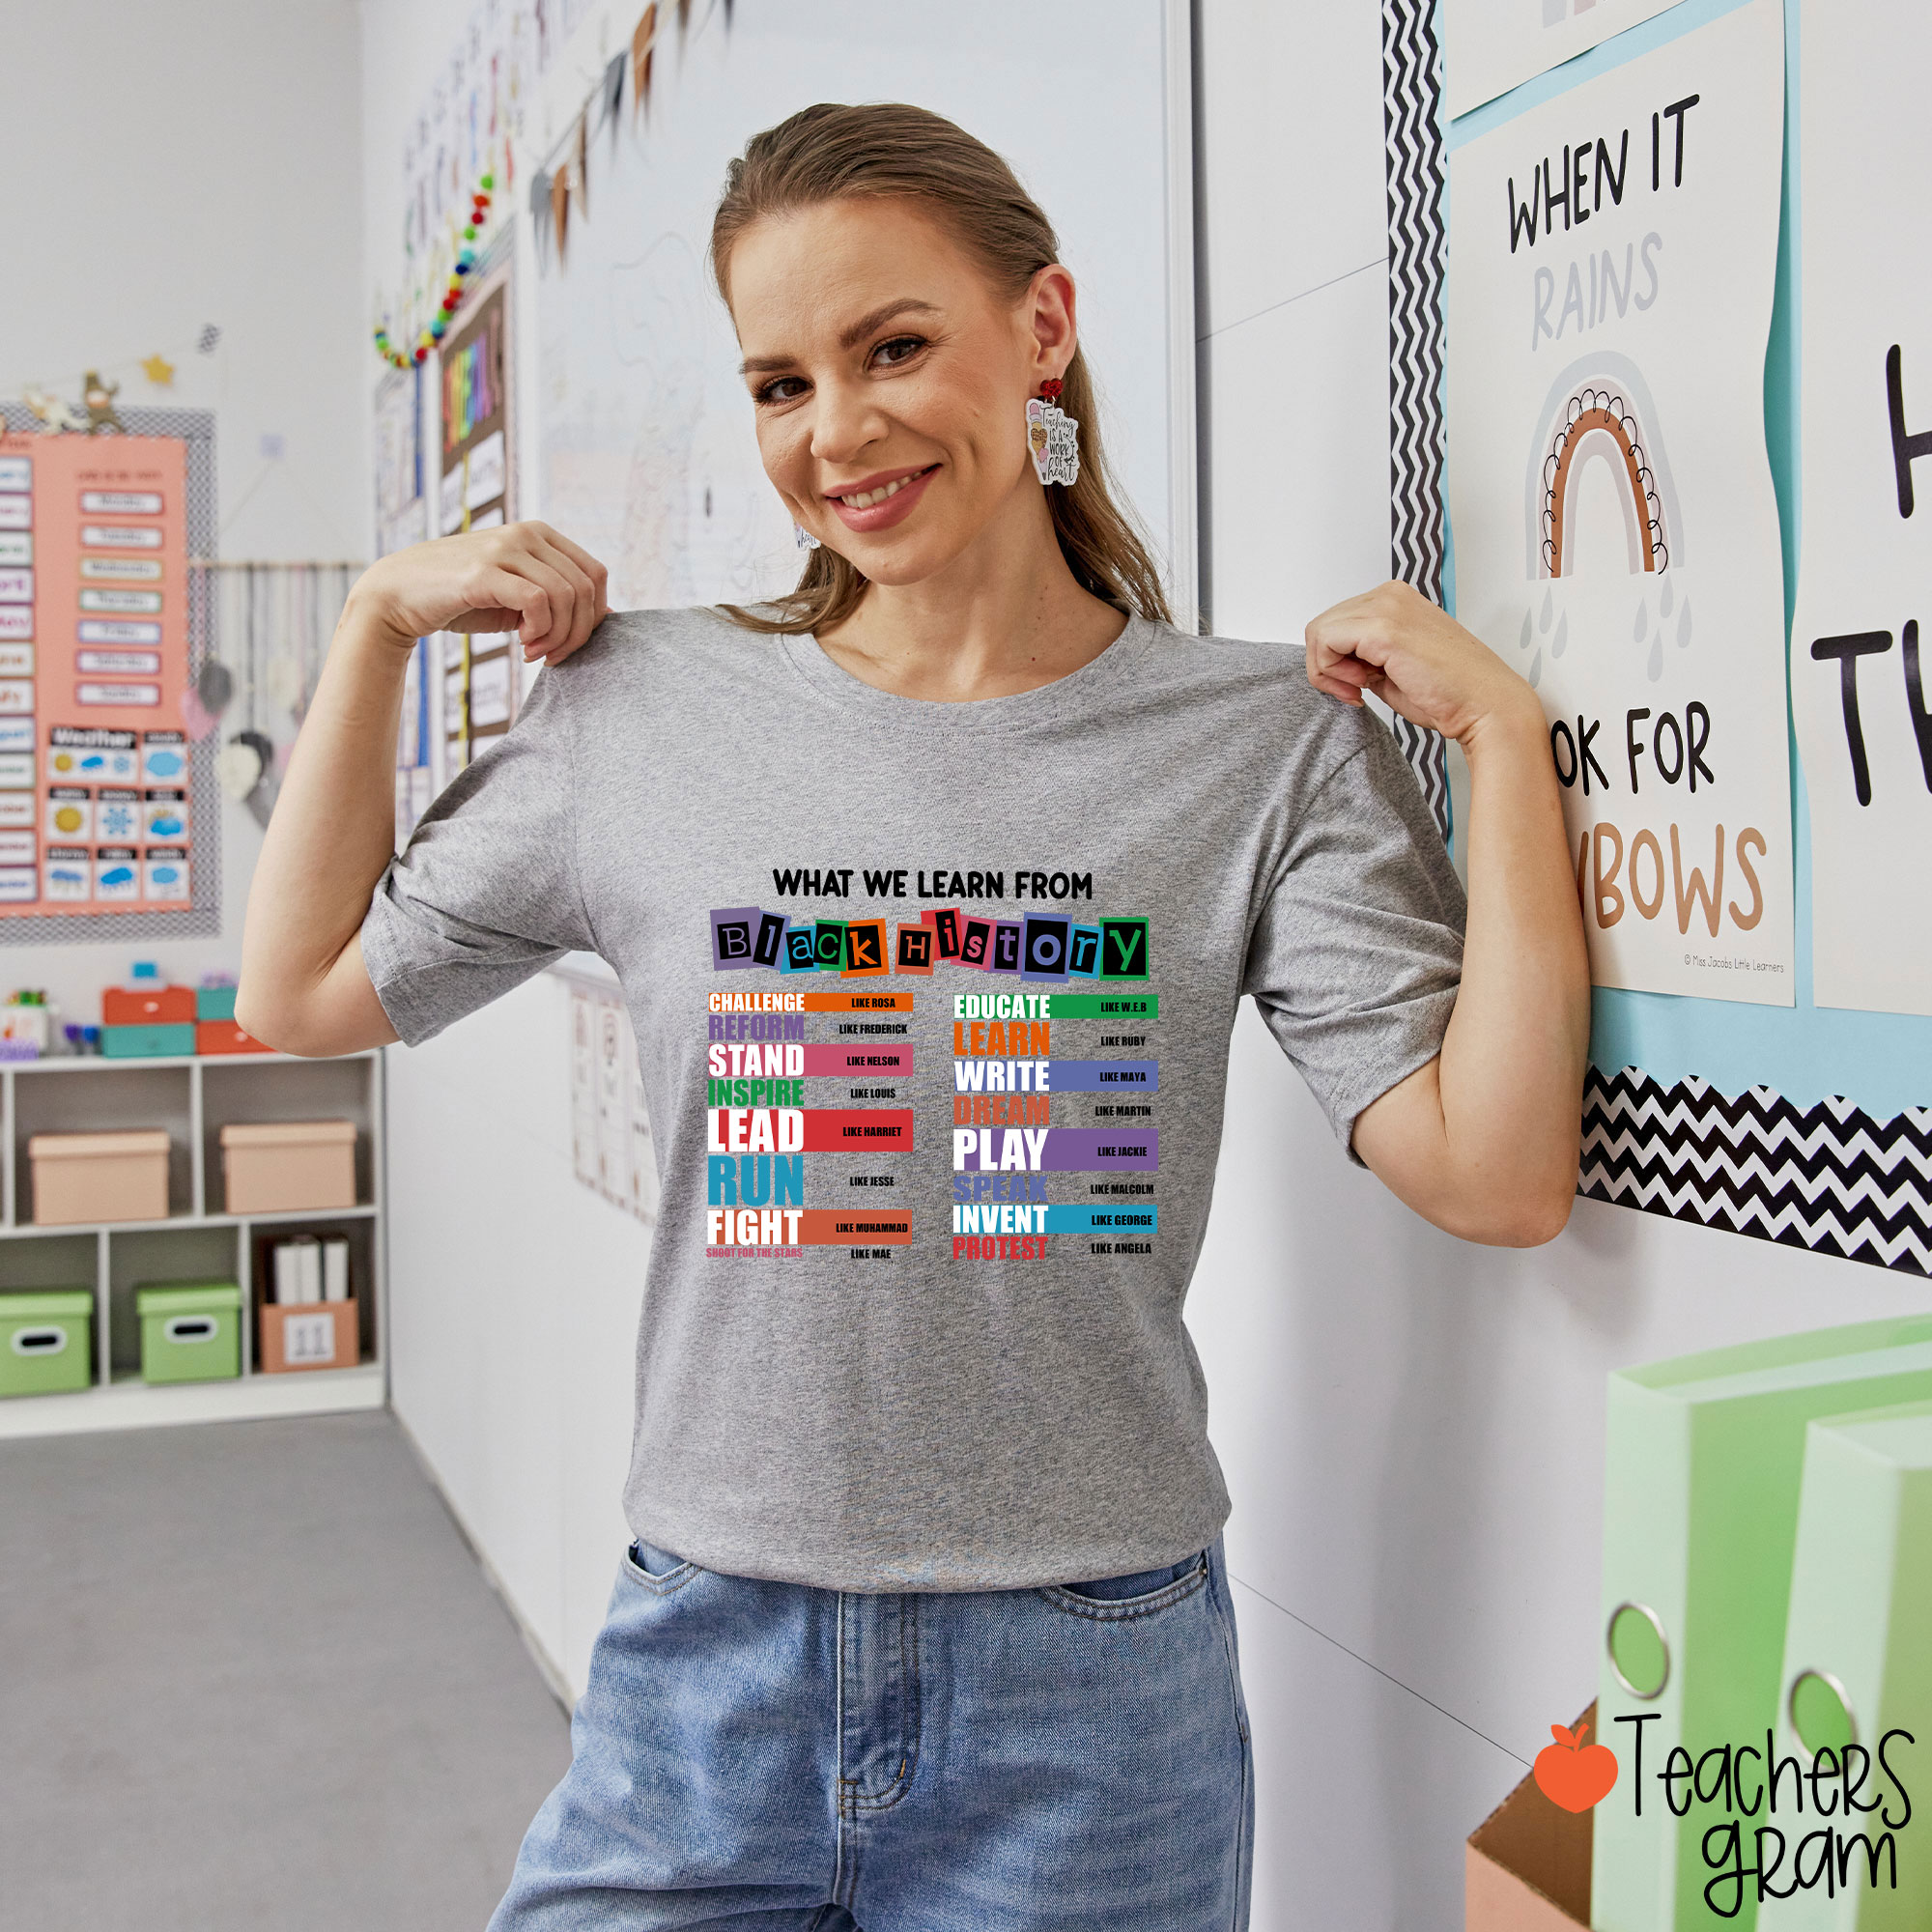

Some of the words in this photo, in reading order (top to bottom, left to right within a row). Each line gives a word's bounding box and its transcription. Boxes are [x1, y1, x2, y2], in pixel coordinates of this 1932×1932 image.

[1508, 129, 1628, 254] WHEN
[1652, 94, 1700, 191] IT
[1532, 232, 1662, 352] RAINS
[1050, 429, 1056, 441] IS
[1059, 430, 1063, 441] A
[1050, 443, 1068, 456] WORK
[1048, 457, 1076, 481] heart
[1055, 456, 1063, 467] OF
[1550, 715, 1609, 796] OK
[1627, 701, 1715, 794] FOR
[773, 869, 853, 897] WHAT
[864, 870, 908, 896] WE
[919, 871, 1003, 898] LEARN
[1016, 872, 1092, 899] FROM
[1577, 822, 1767, 938] BOWS
[721, 923, 880, 968] Black
[903, 916, 1143, 972] History
[1707, 955, 1732, 969] Jacobs
[1734, 957, 1750, 970] Little
[1752, 959, 1784, 973] Learners
[710, 994, 804, 1011] CHALLENGE
[851, 997, 869, 1009] LIKE
[872, 997, 895, 1009] ROSA
[954, 995, 1050, 1018] EDUCATE
[1100, 1002, 1119, 1013] LIKE
[1122, 1002, 1148, 1012] W.E.B
[709, 1015, 804, 1039] REFORM
[838, 1024, 858, 1035] LIKE
[861, 1024, 908, 1035] FREDERICK
[954, 1021, 1050, 1056] LEARN
[1100, 1036, 1120, 1047] LIKE
[1122, 1036, 1147, 1047] RUBY
[709, 1044, 804, 1076] STAND
[846, 1056, 865, 1066] LIKE
[867, 1056, 900, 1066] NELSON
[954, 1062, 1049, 1091] WRITE
[1099, 1071, 1118, 1082] LIKE
[1121, 1071, 1147, 1083] MAYA
[708, 1079, 804, 1106] INSPIRE
[850, 1088, 868, 1099] LIKE
[871, 1088, 896, 1099] LOUIS
[953, 1095, 1049, 1124] DREAM
[1094, 1105, 1114, 1117] LIKE
[1117, 1105, 1151, 1117] MARTIN
[708, 1109, 803, 1151] LEAD
[842, 1126, 862, 1137] LIKE
[865, 1126, 902, 1137] HARRIET
[953, 1129, 1048, 1170] PLAY
[1097, 1146, 1116, 1157] LIKE
[1119, 1146, 1148, 1157] JACKIE
[708, 1155, 803, 1207] RUN
[849, 1176, 867, 1186] LIKE
[870, 1176, 895, 1187] JESSE
[954, 1177, 1047, 1201] SPEAK
[1090, 1183, 1109, 1195] LIKE
[1111, 1183, 1154, 1195] MALCOLM
[707, 1210, 803, 1245] FIGHT
[836, 1223, 853, 1234] LIKE
[856, 1223, 908, 1234] MUHAMMAD
[953, 1206, 1048, 1233] INVENT
[1091, 1214, 1112, 1226] LIKE
[1114, 1214, 1152, 1226] GEORGE
[705, 1247, 736, 1259] SHOOT
[737, 1247, 754, 1259] FOR
[755, 1247, 773, 1259] THE
[774, 1247, 804, 1259] STARS
[850, 1248, 869, 1260] LIKE
[872, 1248, 892, 1260] MAE
[953, 1236, 1048, 1260] PROTEST
[1091, 1242, 1112, 1255] LIKE
[1114, 1242, 1152, 1254] ANGELA
